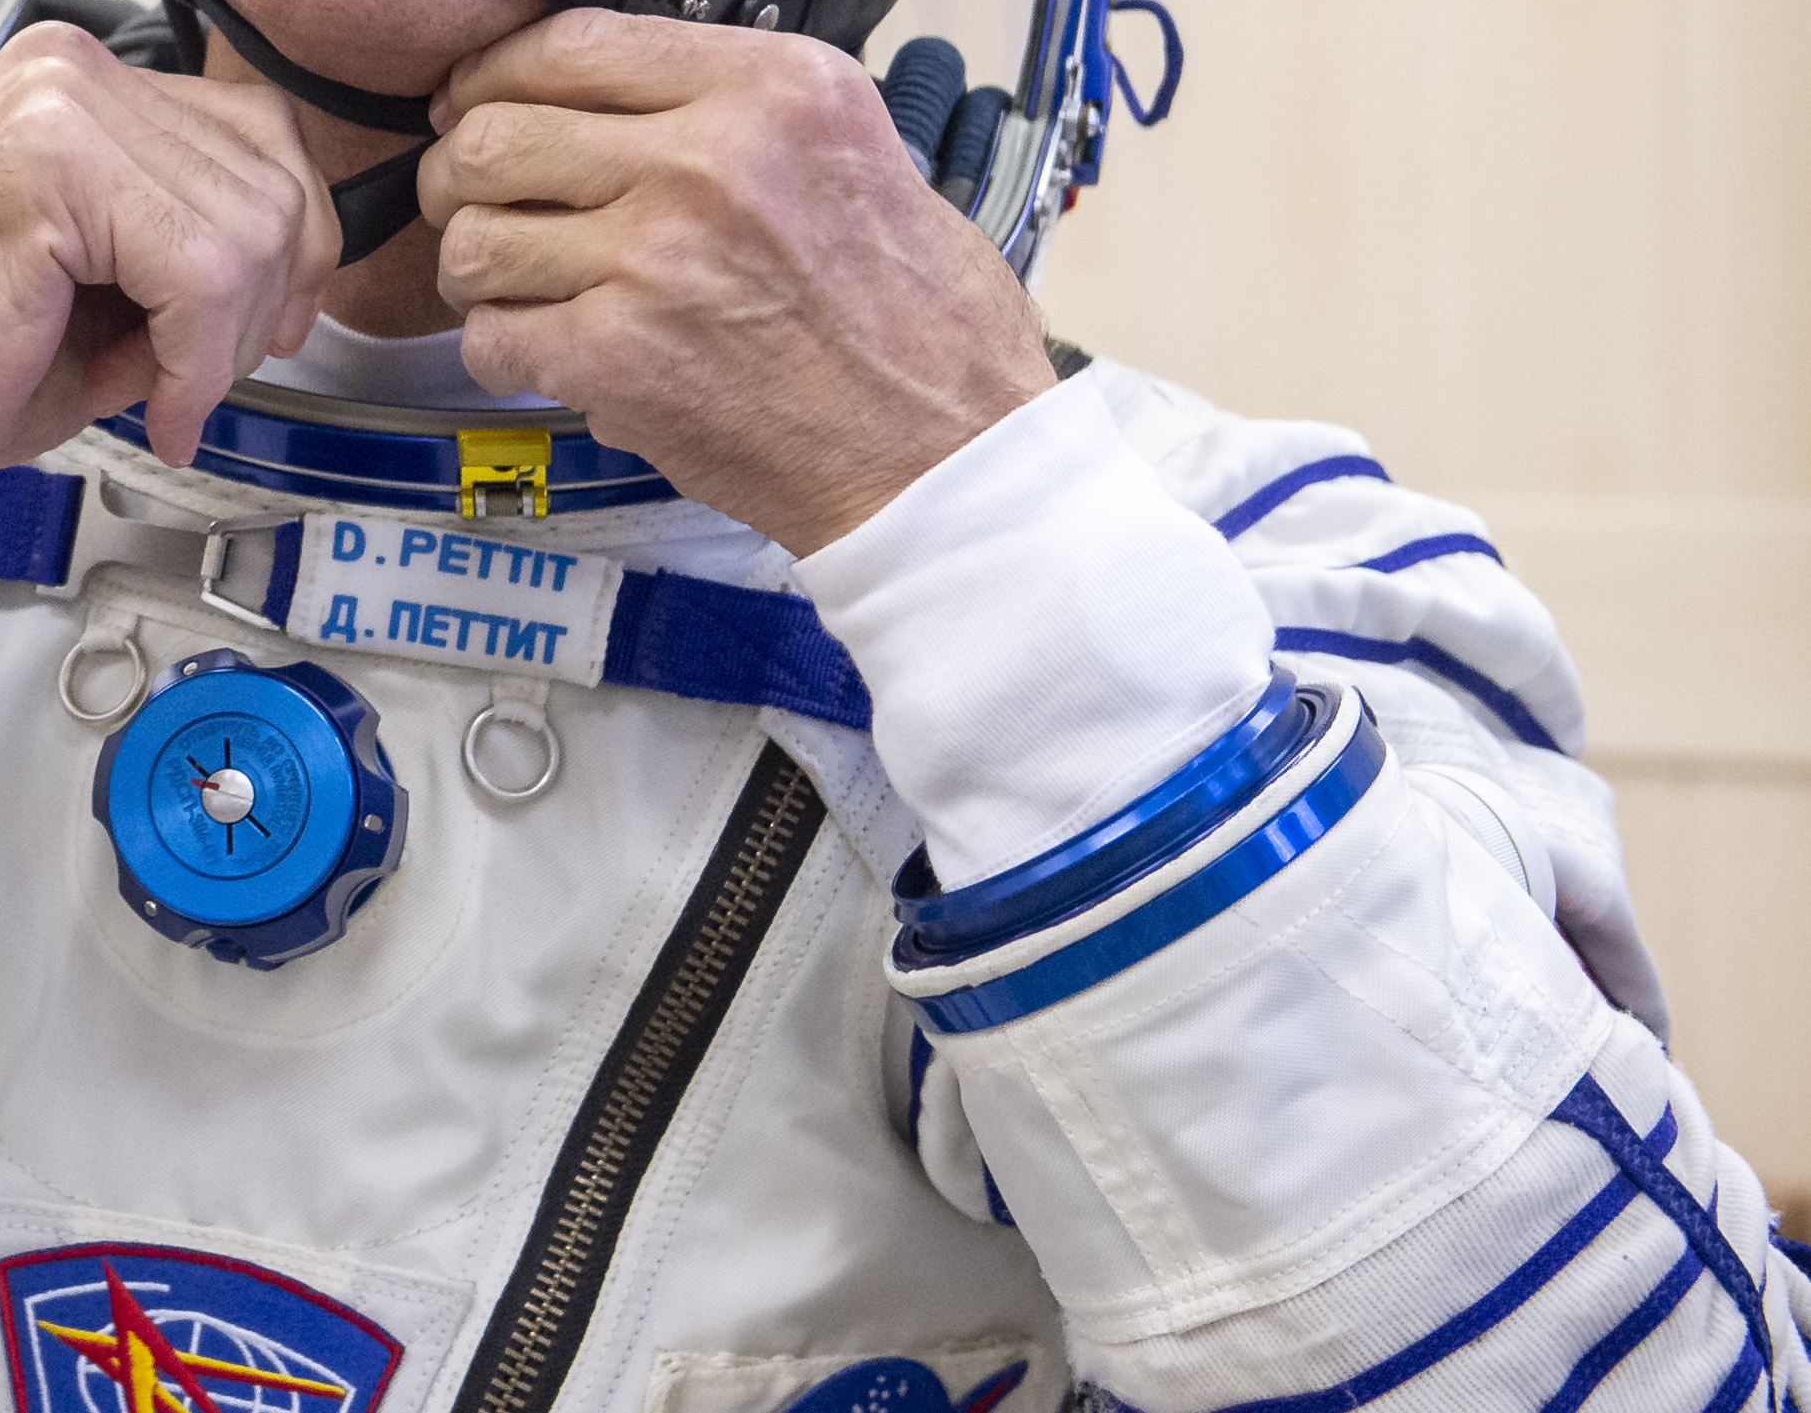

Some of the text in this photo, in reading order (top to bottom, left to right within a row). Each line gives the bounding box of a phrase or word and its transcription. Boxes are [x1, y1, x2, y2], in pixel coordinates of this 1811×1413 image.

[332, 521, 577, 592] D. PETTIT
[320, 594, 568, 664] Д. ПЕТТИТ
